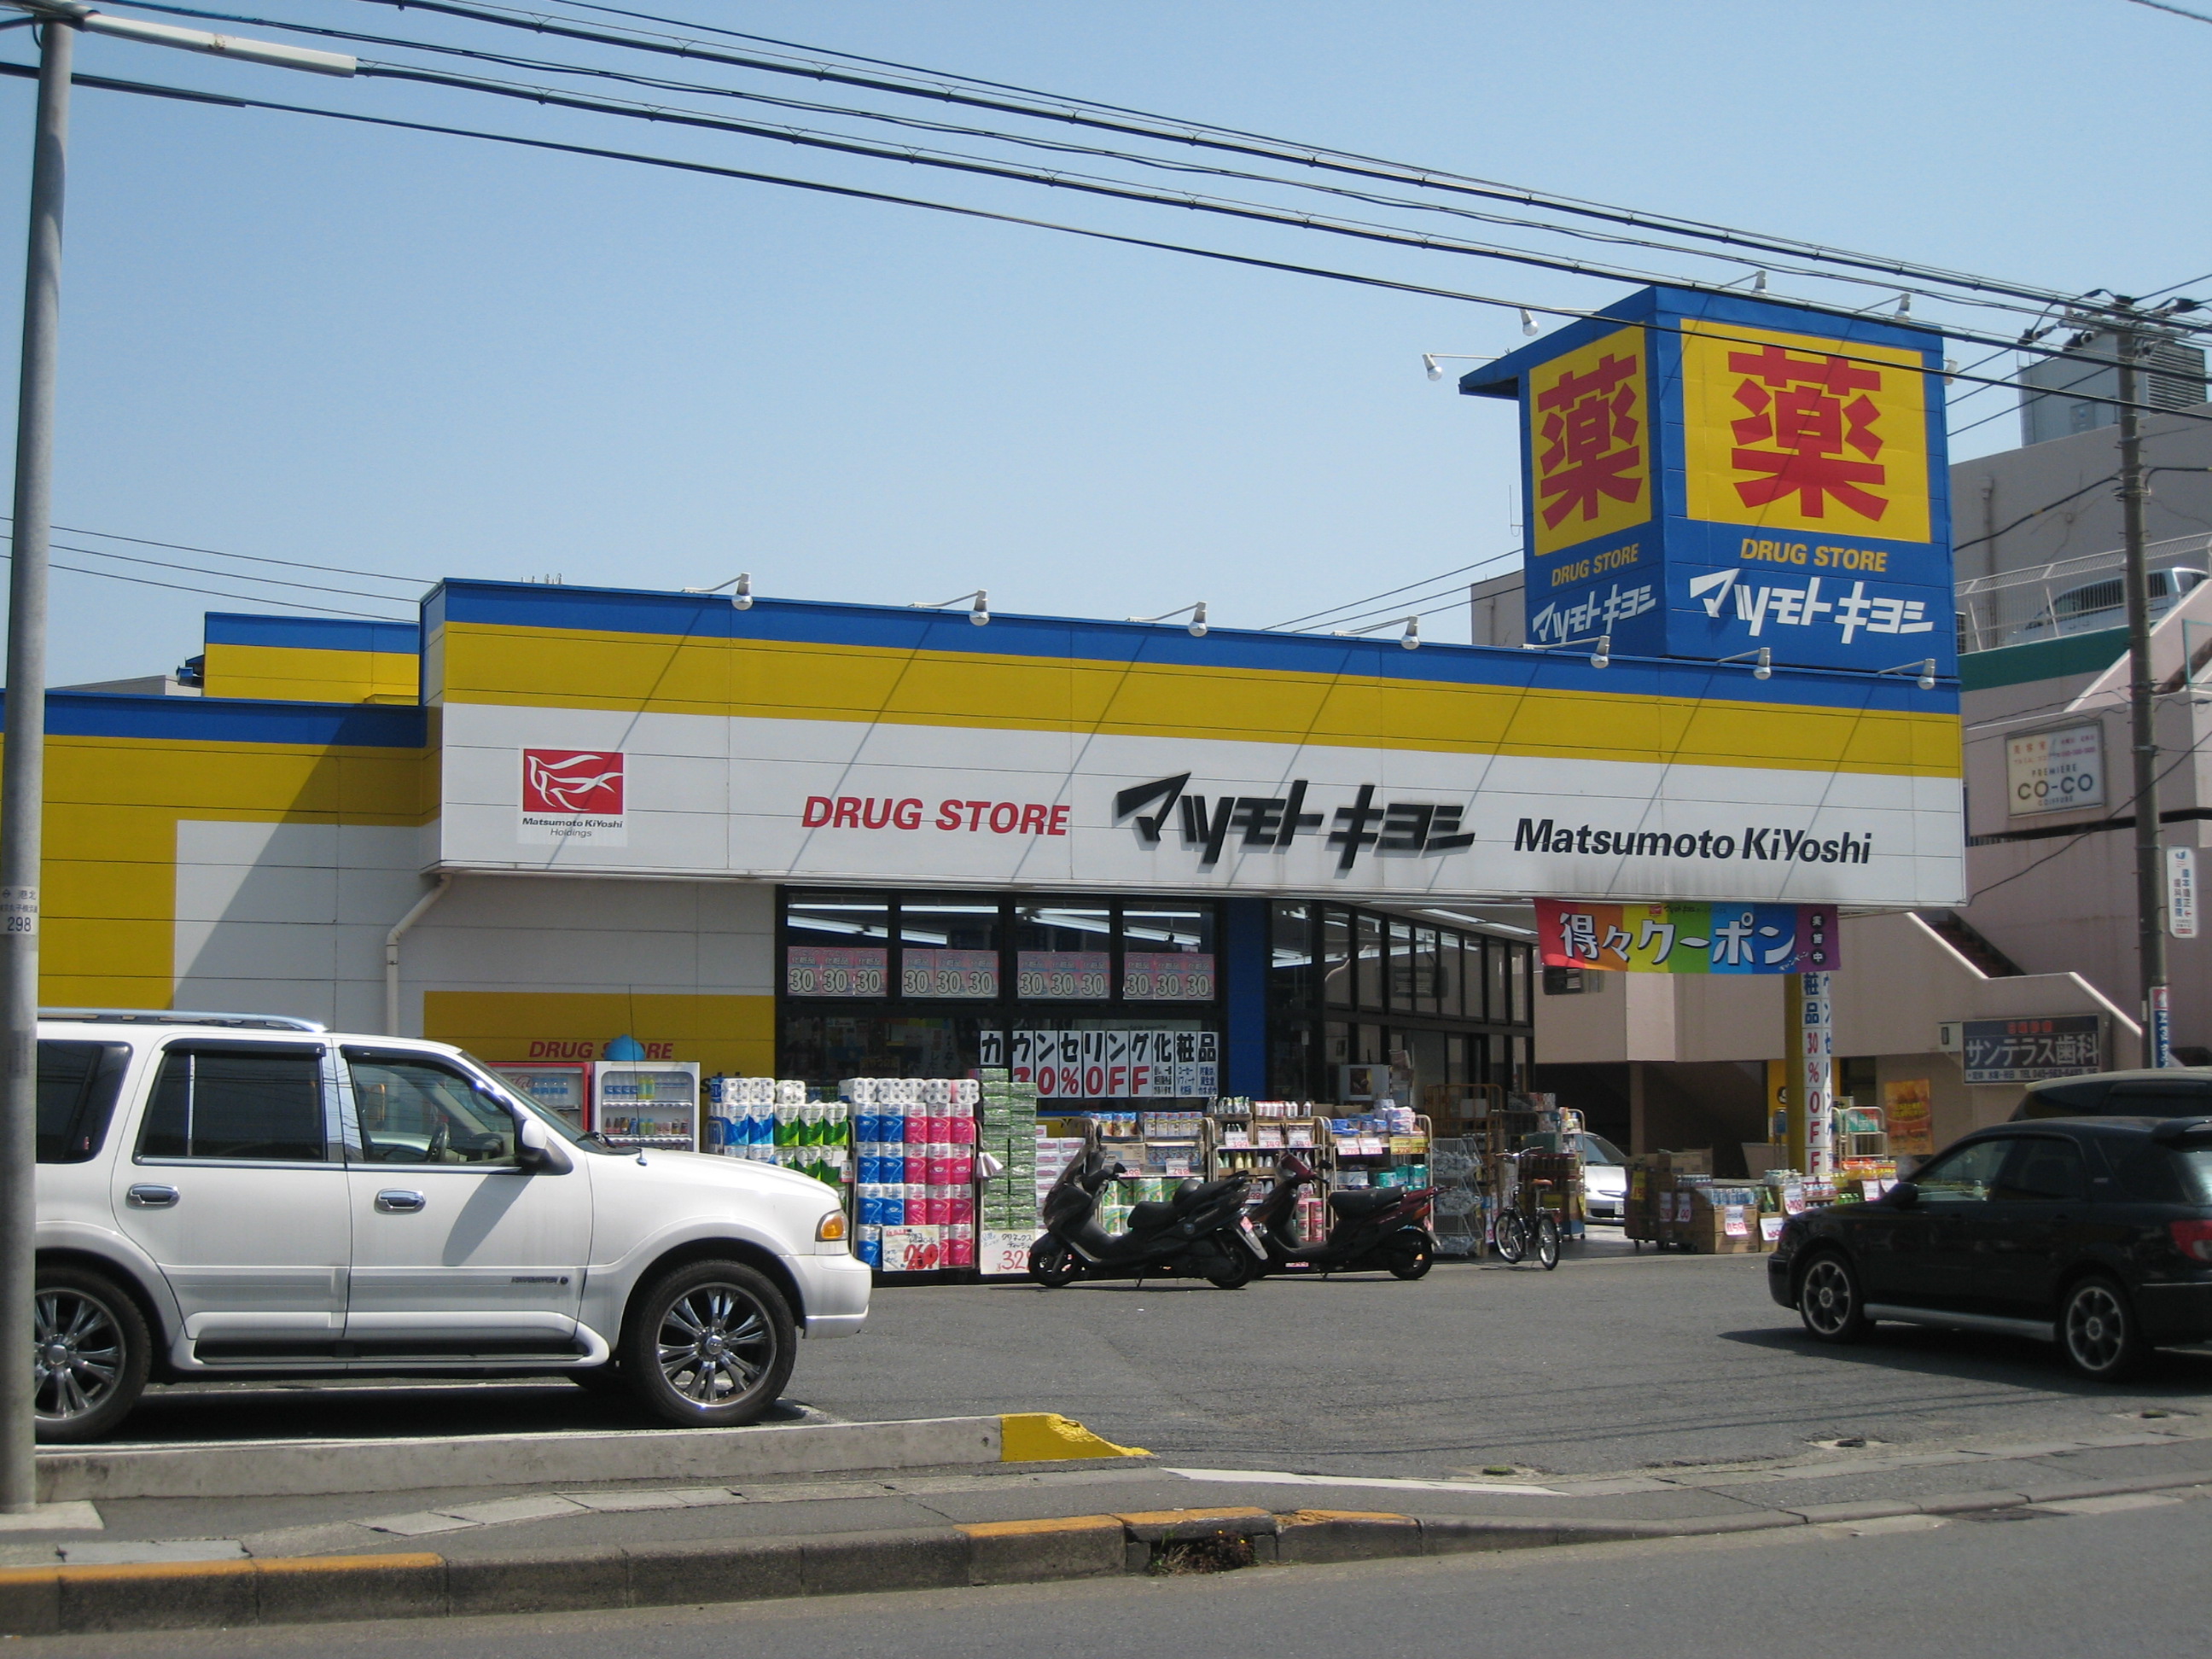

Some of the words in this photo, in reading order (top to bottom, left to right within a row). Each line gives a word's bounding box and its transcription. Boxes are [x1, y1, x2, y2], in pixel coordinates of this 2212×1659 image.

[1538, 354, 1643, 530] 薬
[1728, 345, 1889, 521] 薬
[1551, 558, 1589, 587] DRUG
[1592, 543, 1639, 574] STORE
[1740, 538, 1808, 565] DRUG
[1813, 544, 1888, 573] STORE
[1532, 584, 1656, 642] マツモトキヨシ
[1690, 568, 1934, 643] マツモトキヨシ
[522, 817, 584, 827] Matsumoto
[585, 819, 623, 829] KiYoshi
[550, 828, 592, 838] Holdings
[802, 795, 923, 830] DRUG
[935, 800, 1070, 836] STORE
[1116, 772, 1476, 870] マツモトキヨシ
[1515, 818, 1734, 860] Matsumoto
[1741, 826, 1872, 864] KiYoshi
[8, 917, 32, 932] 298
[1560, 912, 1796, 965] 得々クーポン
[528, 1041, 593, 1057] DRUG
[1965, 1033, 2099, 1066] サンテラス歯科
[904, 1243, 939, 1271] 269
